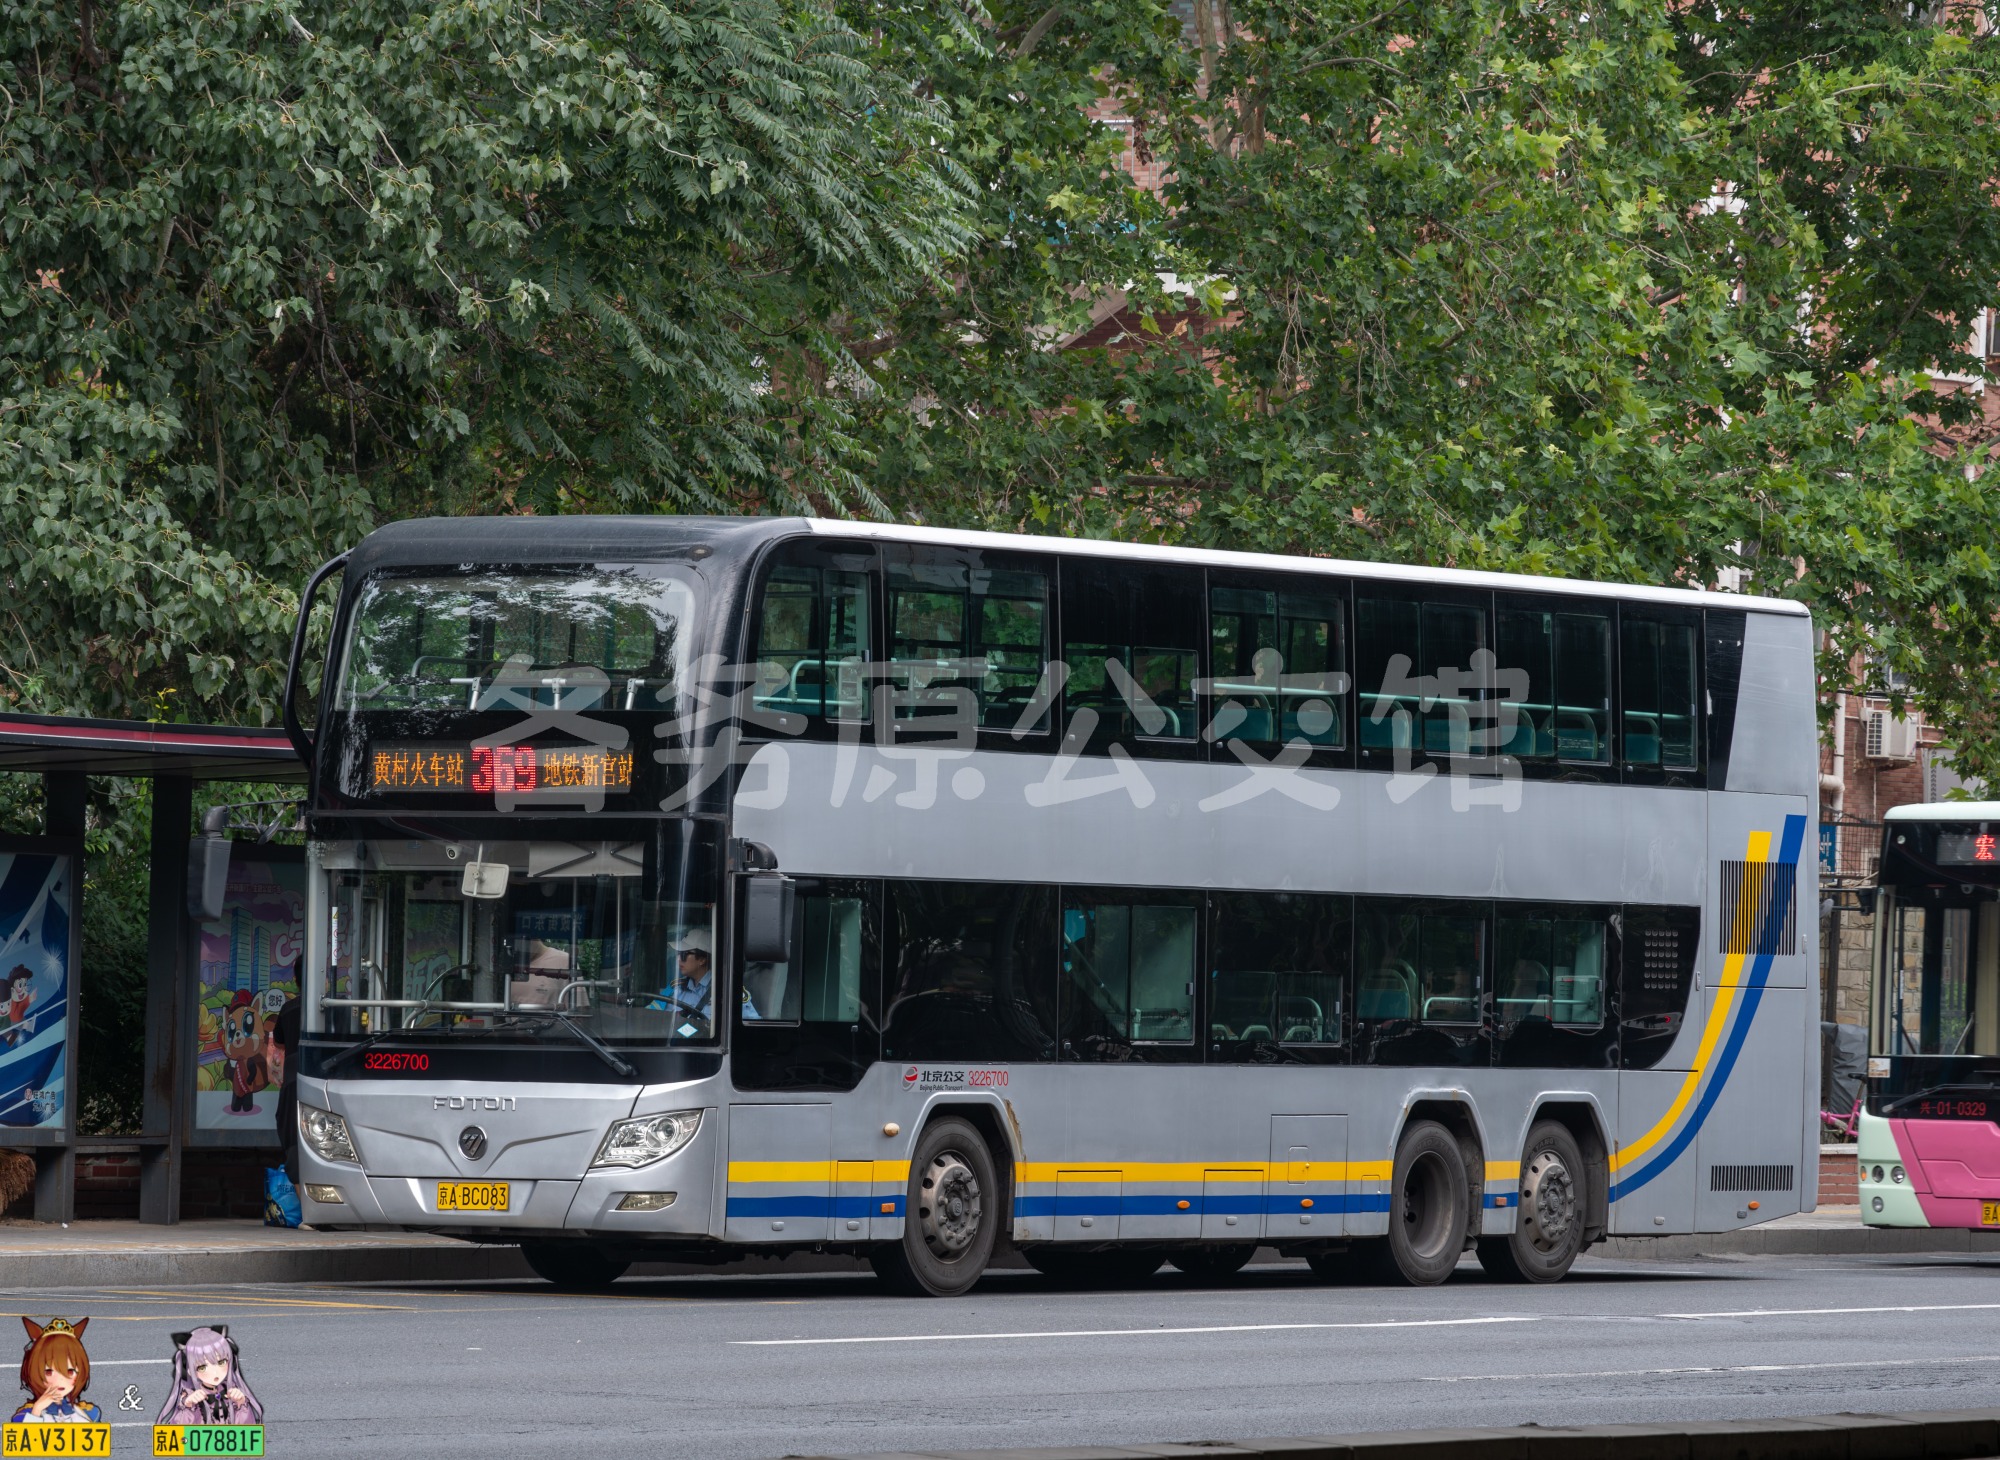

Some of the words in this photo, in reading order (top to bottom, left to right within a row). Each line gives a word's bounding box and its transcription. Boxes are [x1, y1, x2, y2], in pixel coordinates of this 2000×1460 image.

[373, 752, 464, 787] 黄村火车站
[471, 746, 537, 792] 369
[268, 994, 283, 1007] 您好
[364, 1053, 429, 1072] 3226700
[920, 1070, 965, 1083] 北京公交
[968, 1070, 1009, 1087] 3226700
[433, 1096, 516, 1112] FOTON
[1920, 1101, 1987, 1116] 兴-01-0329
